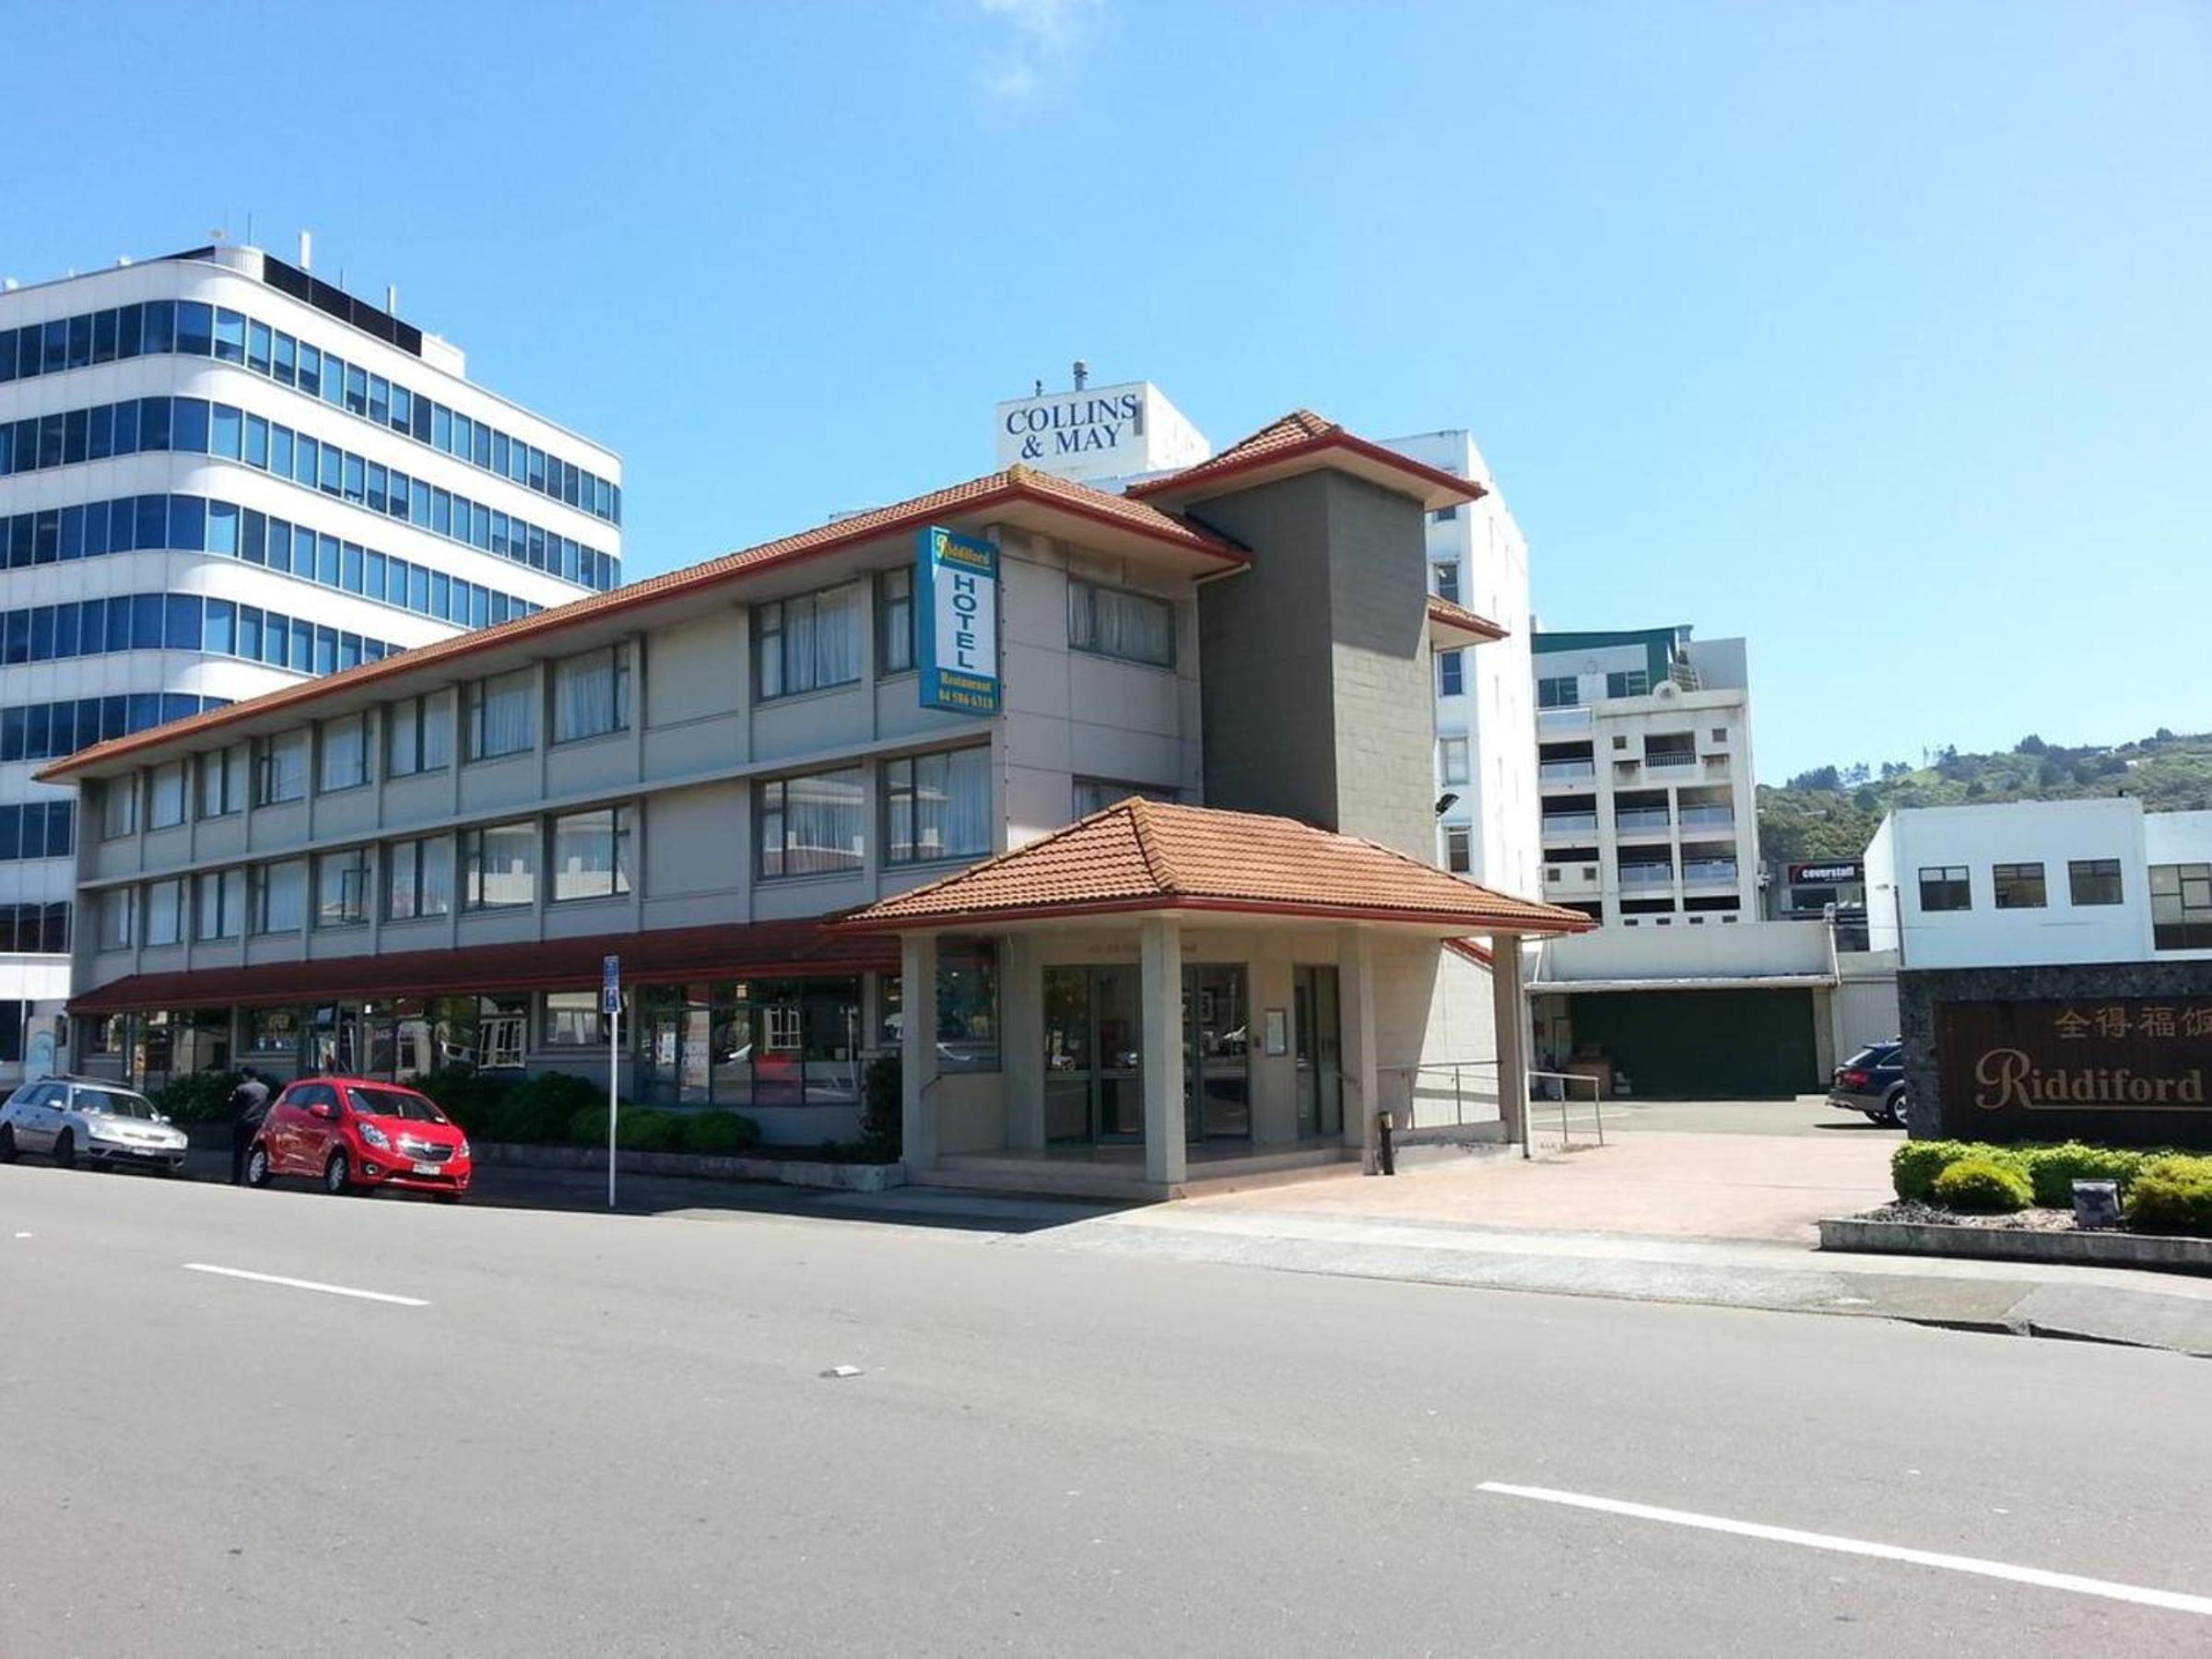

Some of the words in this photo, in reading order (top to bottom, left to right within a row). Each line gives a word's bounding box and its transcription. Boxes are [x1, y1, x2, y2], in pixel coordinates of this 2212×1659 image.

[1006, 394, 1137, 436] COLLINS
[1021, 435, 1043, 460] &
[1055, 422, 1123, 455] MAY
[952, 573, 977, 669] HOTEL
[1974, 1048, 2204, 1110] Riddiford
